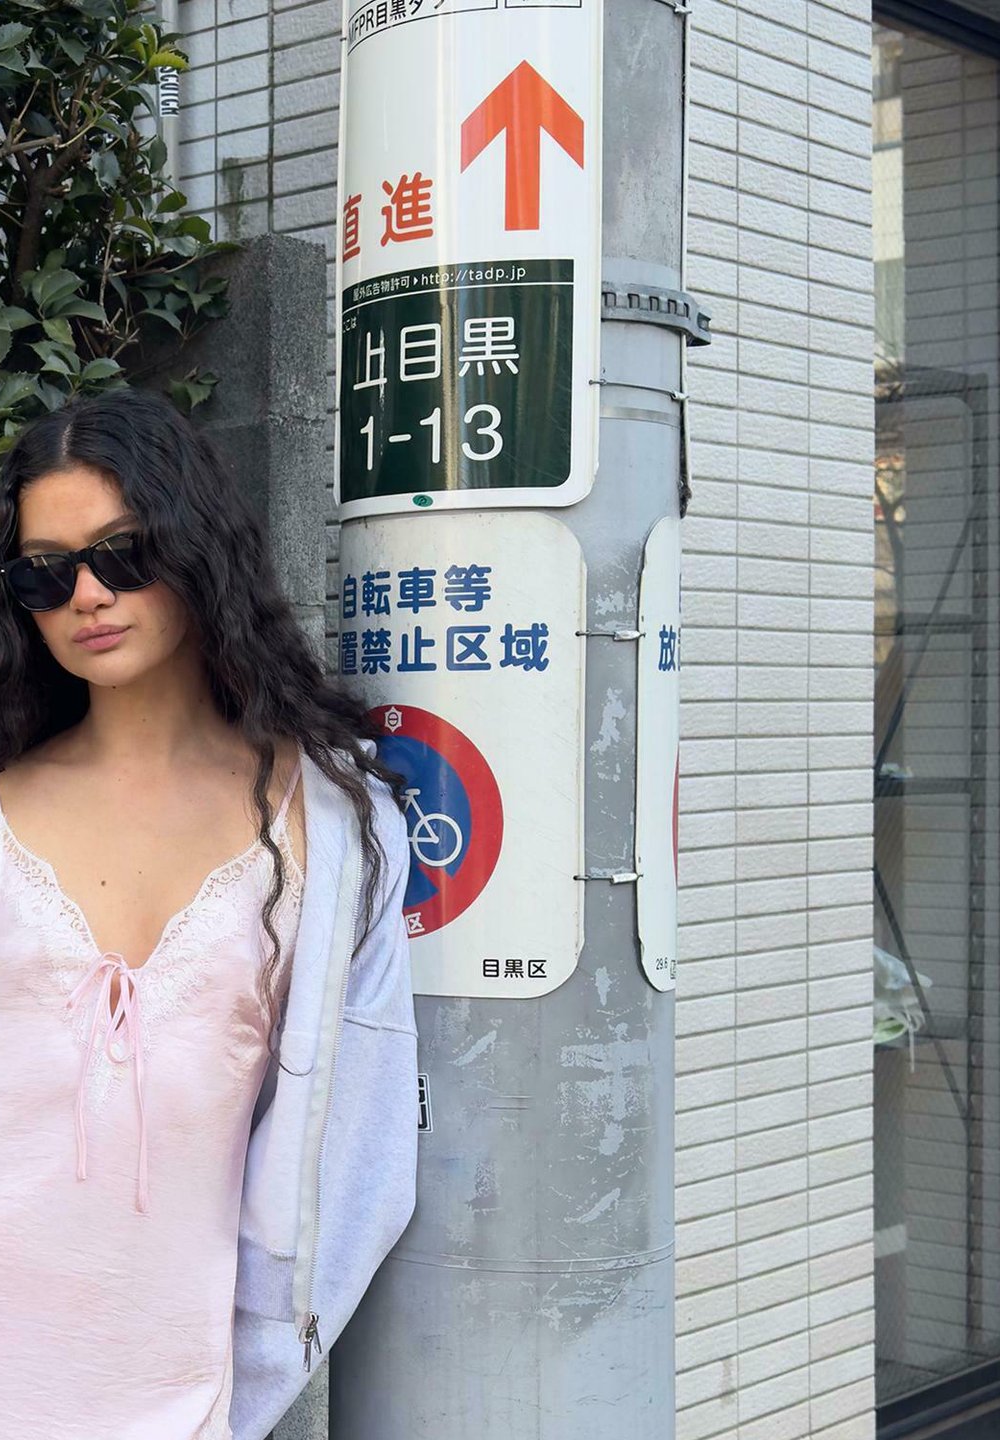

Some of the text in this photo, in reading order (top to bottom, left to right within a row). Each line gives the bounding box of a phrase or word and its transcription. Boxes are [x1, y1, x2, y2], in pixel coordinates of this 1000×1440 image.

[421, 266, 526, 286] http://tadp.jp
[353, 317, 520, 391] 上目黒
[360, 404, 504, 471] 1-13
[343, 564, 492, 619] 自転車等
[659, 624, 681, 671] 放
[483, 959, 547, 978] 目黒区
